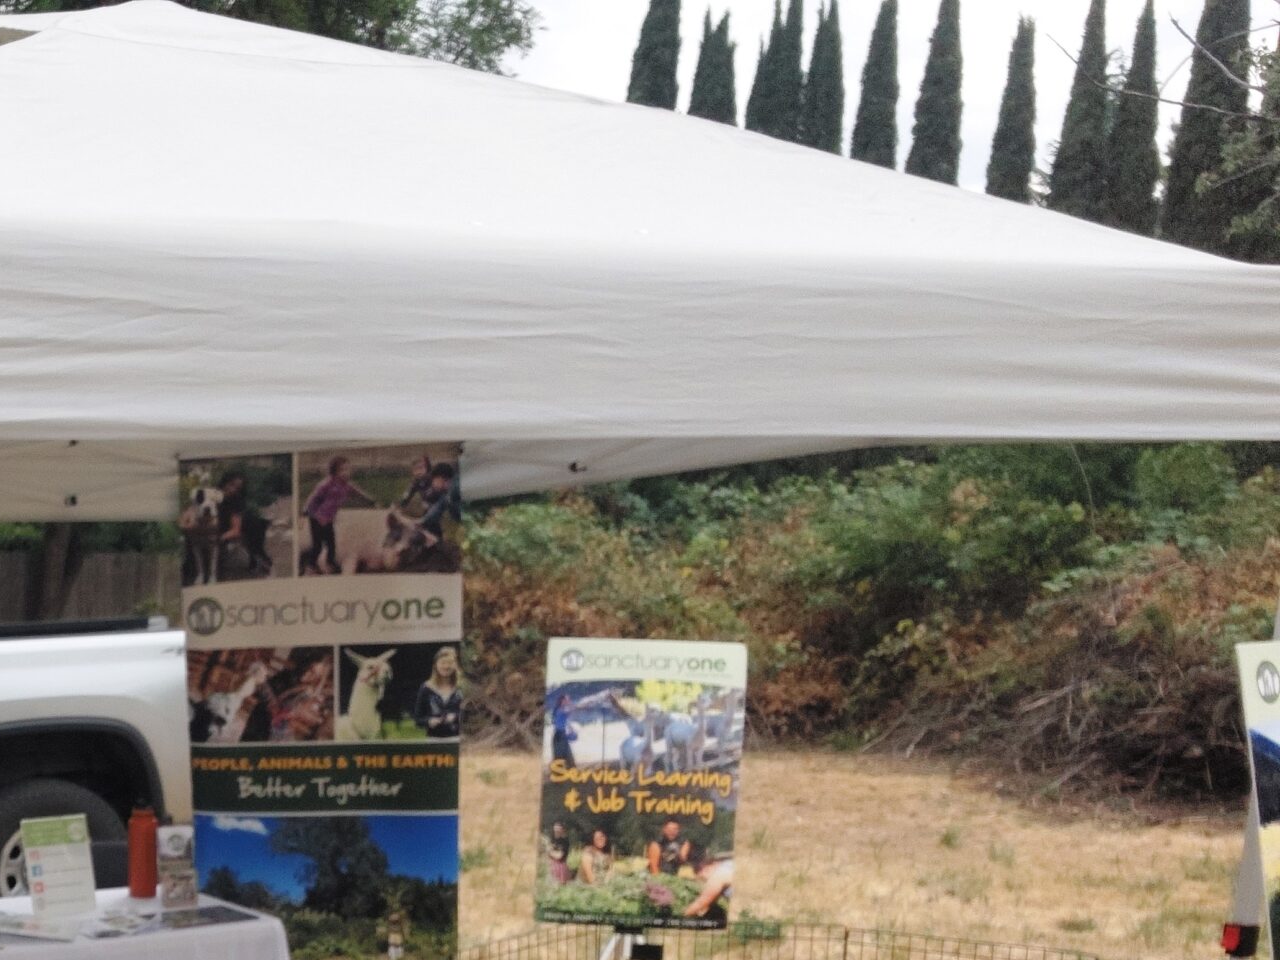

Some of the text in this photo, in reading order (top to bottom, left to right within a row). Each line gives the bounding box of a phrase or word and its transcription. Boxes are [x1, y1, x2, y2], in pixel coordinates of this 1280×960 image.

[224, 596, 446, 628] sanctuaryone
[587, 653, 726, 673] sanctuaryone
[258, 755, 332, 770] ANIMALS
[355, 755, 387, 769] THE
[549, 759, 732, 797] Service Learning
[238, 775, 403, 805] Better Together
[587, 787, 626, 814] Job
[628, 790, 715, 825] Training
